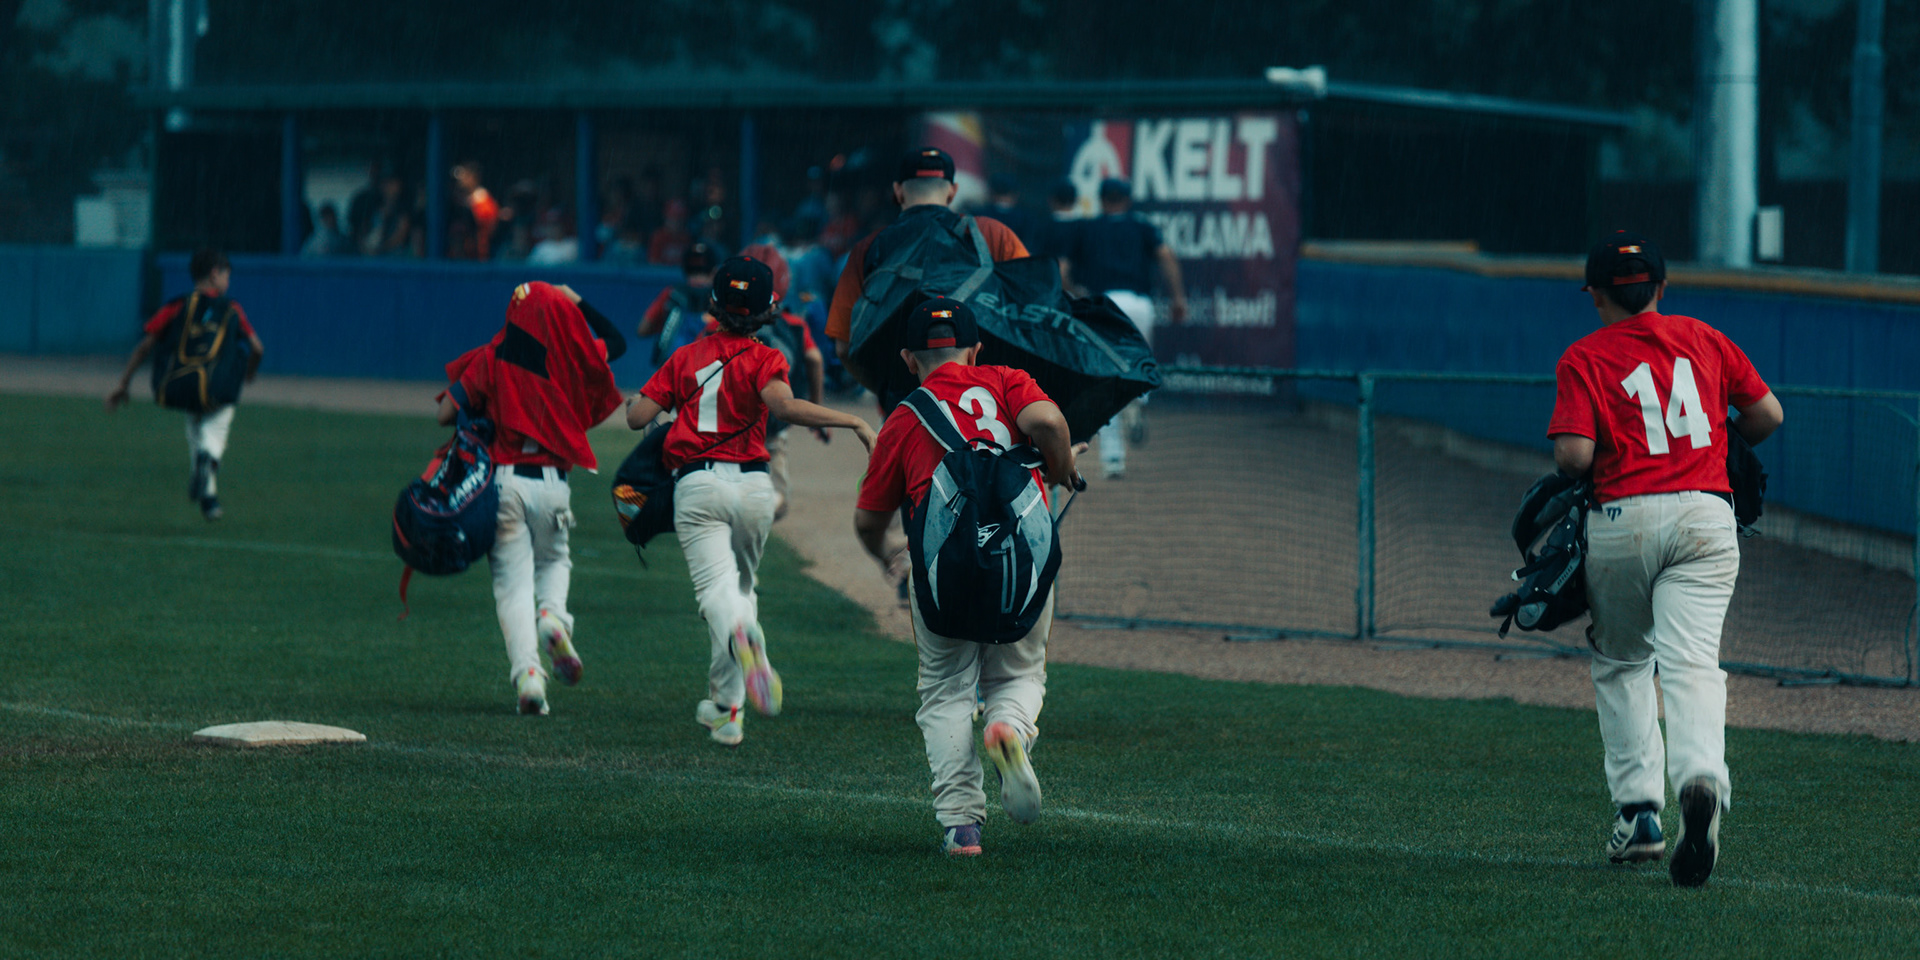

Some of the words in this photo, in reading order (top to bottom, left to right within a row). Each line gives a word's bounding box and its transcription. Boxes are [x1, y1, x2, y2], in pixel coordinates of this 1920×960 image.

[1133, 117, 1278, 200] KELT
[1135, 210, 1276, 259] KLAMA
[694, 360, 723, 432] 1
[937, 386, 1012, 456] 3
[1621, 356, 1712, 455] 14
